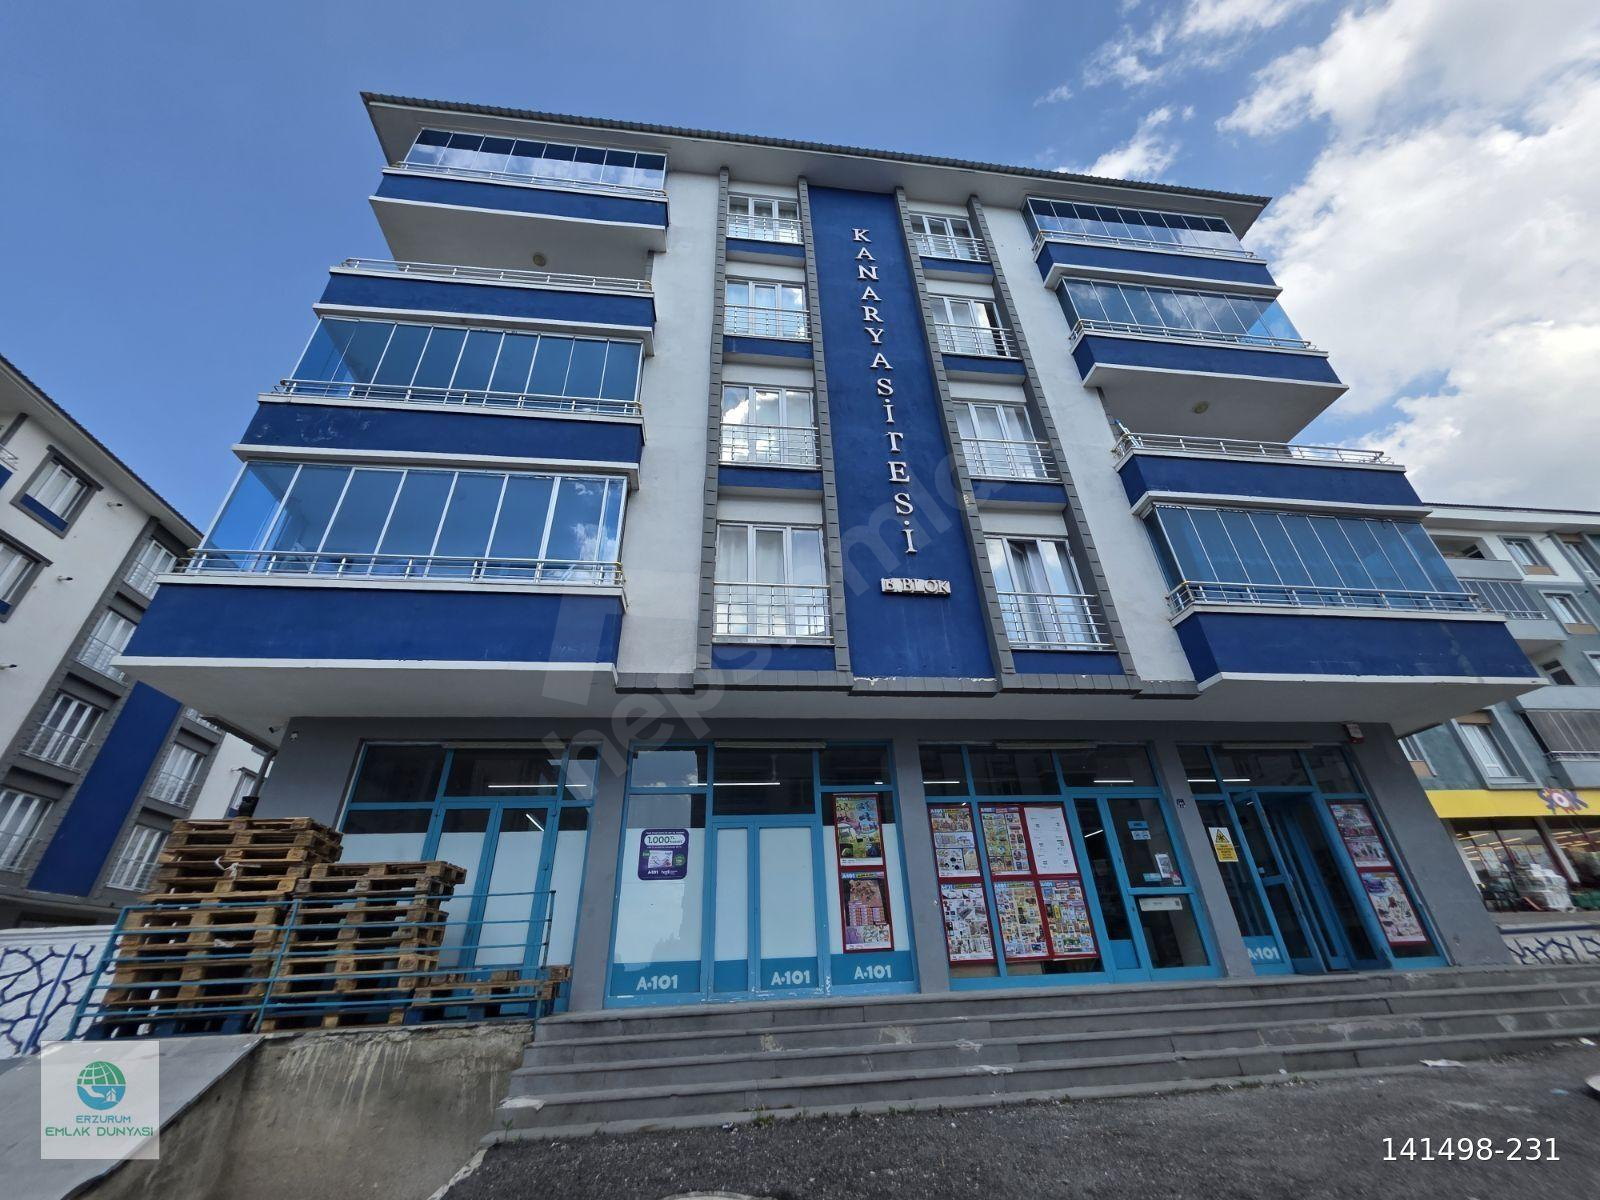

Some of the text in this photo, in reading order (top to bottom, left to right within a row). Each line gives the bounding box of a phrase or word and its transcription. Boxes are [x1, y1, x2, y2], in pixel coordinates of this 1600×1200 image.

[852, 228, 918, 554] KANARYA SİTESİ
[647, 836, 670, 844] 1.000
